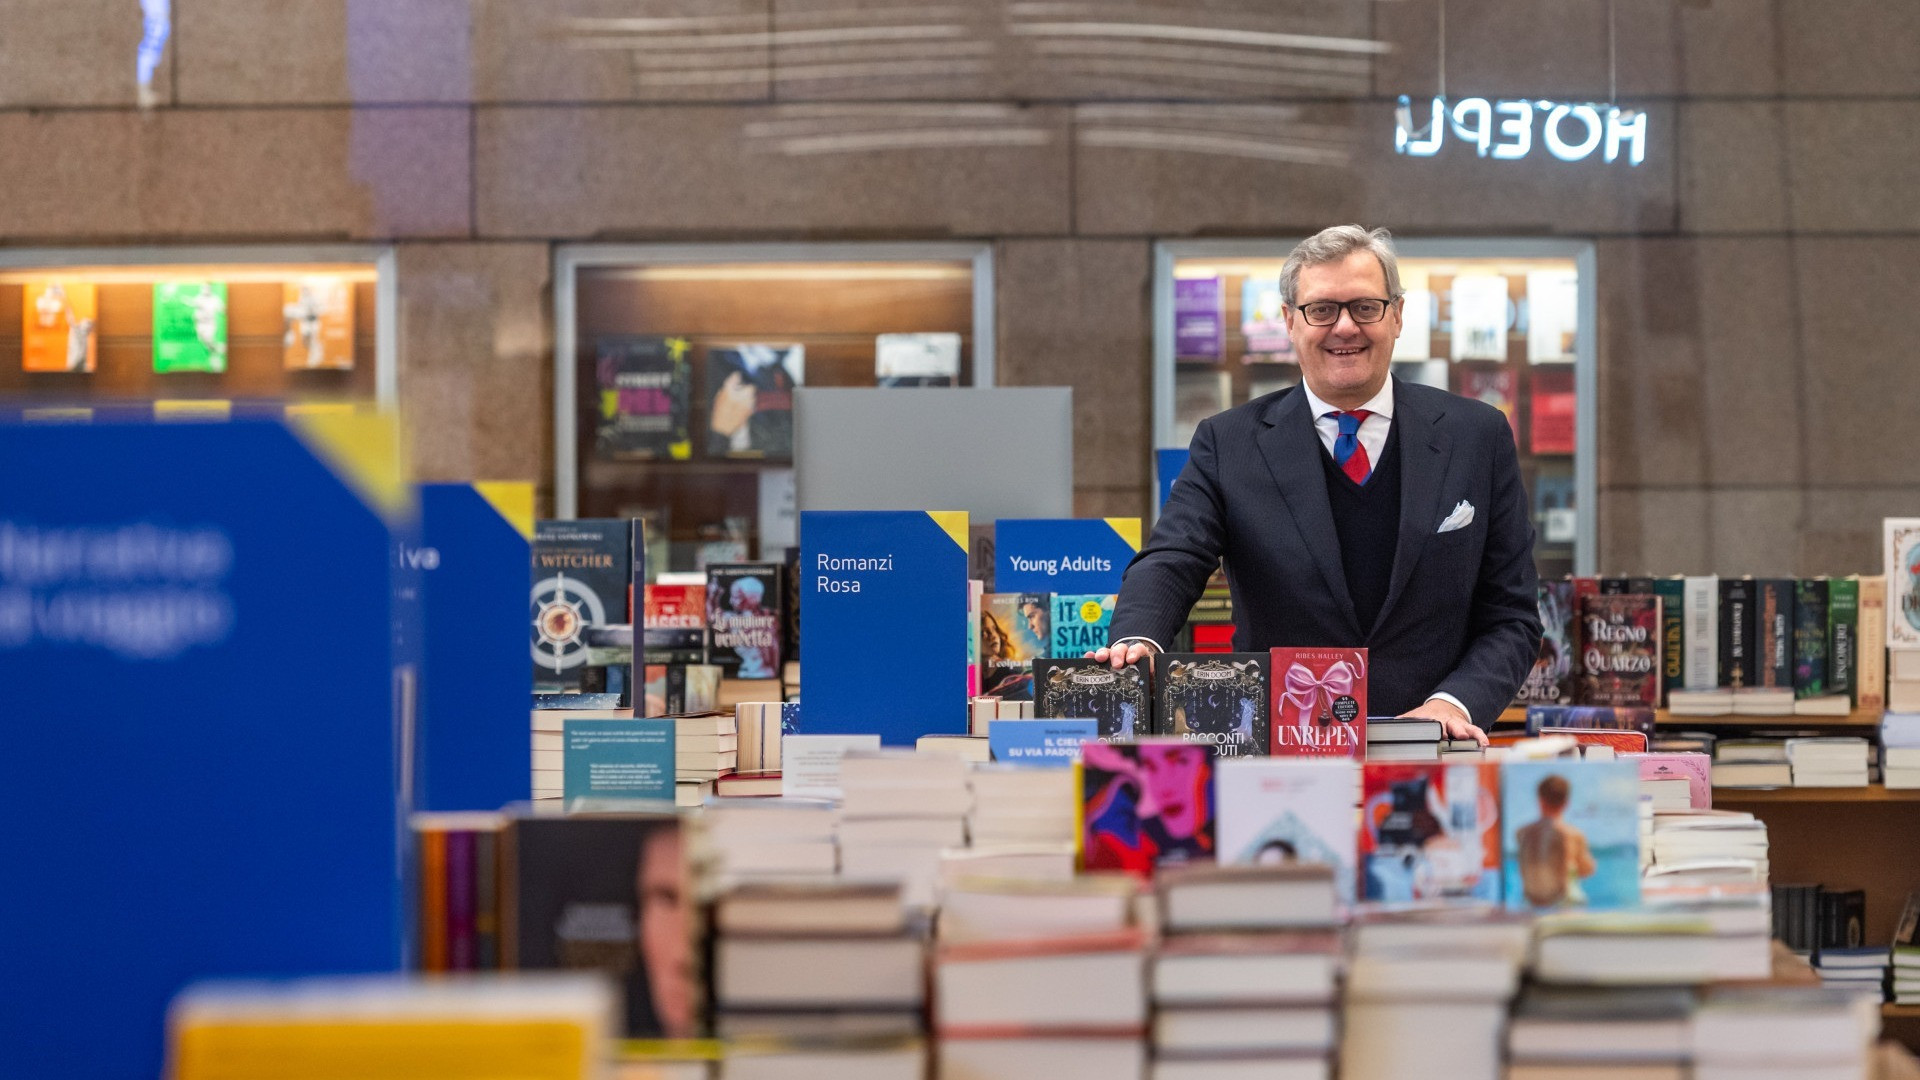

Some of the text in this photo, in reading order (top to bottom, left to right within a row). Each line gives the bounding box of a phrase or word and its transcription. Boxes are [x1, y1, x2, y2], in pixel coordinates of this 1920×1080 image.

[541, 553, 614, 568] WITCHER
[817, 553, 893, 571] Romanzi
[1010, 556, 1112, 575] Young Adults
[817, 575, 861, 593] Rosa
[1059, 601, 1076, 622] IT
[729, 616, 775, 630] migliore
[714, 630, 773, 648] vendetta
[996, 658, 1021, 670] colpa
[1076, 674, 1112, 683] ERIN DOOM
[1210, 670, 1232, 678] DOOM
[1517, 685, 1560, 700] ORLD
[1044, 738, 1087, 747] IL CIELO
[1183, 732, 1245, 744] RACCONTI
[1278, 725, 1359, 746] UNREPEN
[1008, 748, 1022, 758] SU
[1025, 748, 1043, 758] VIA
